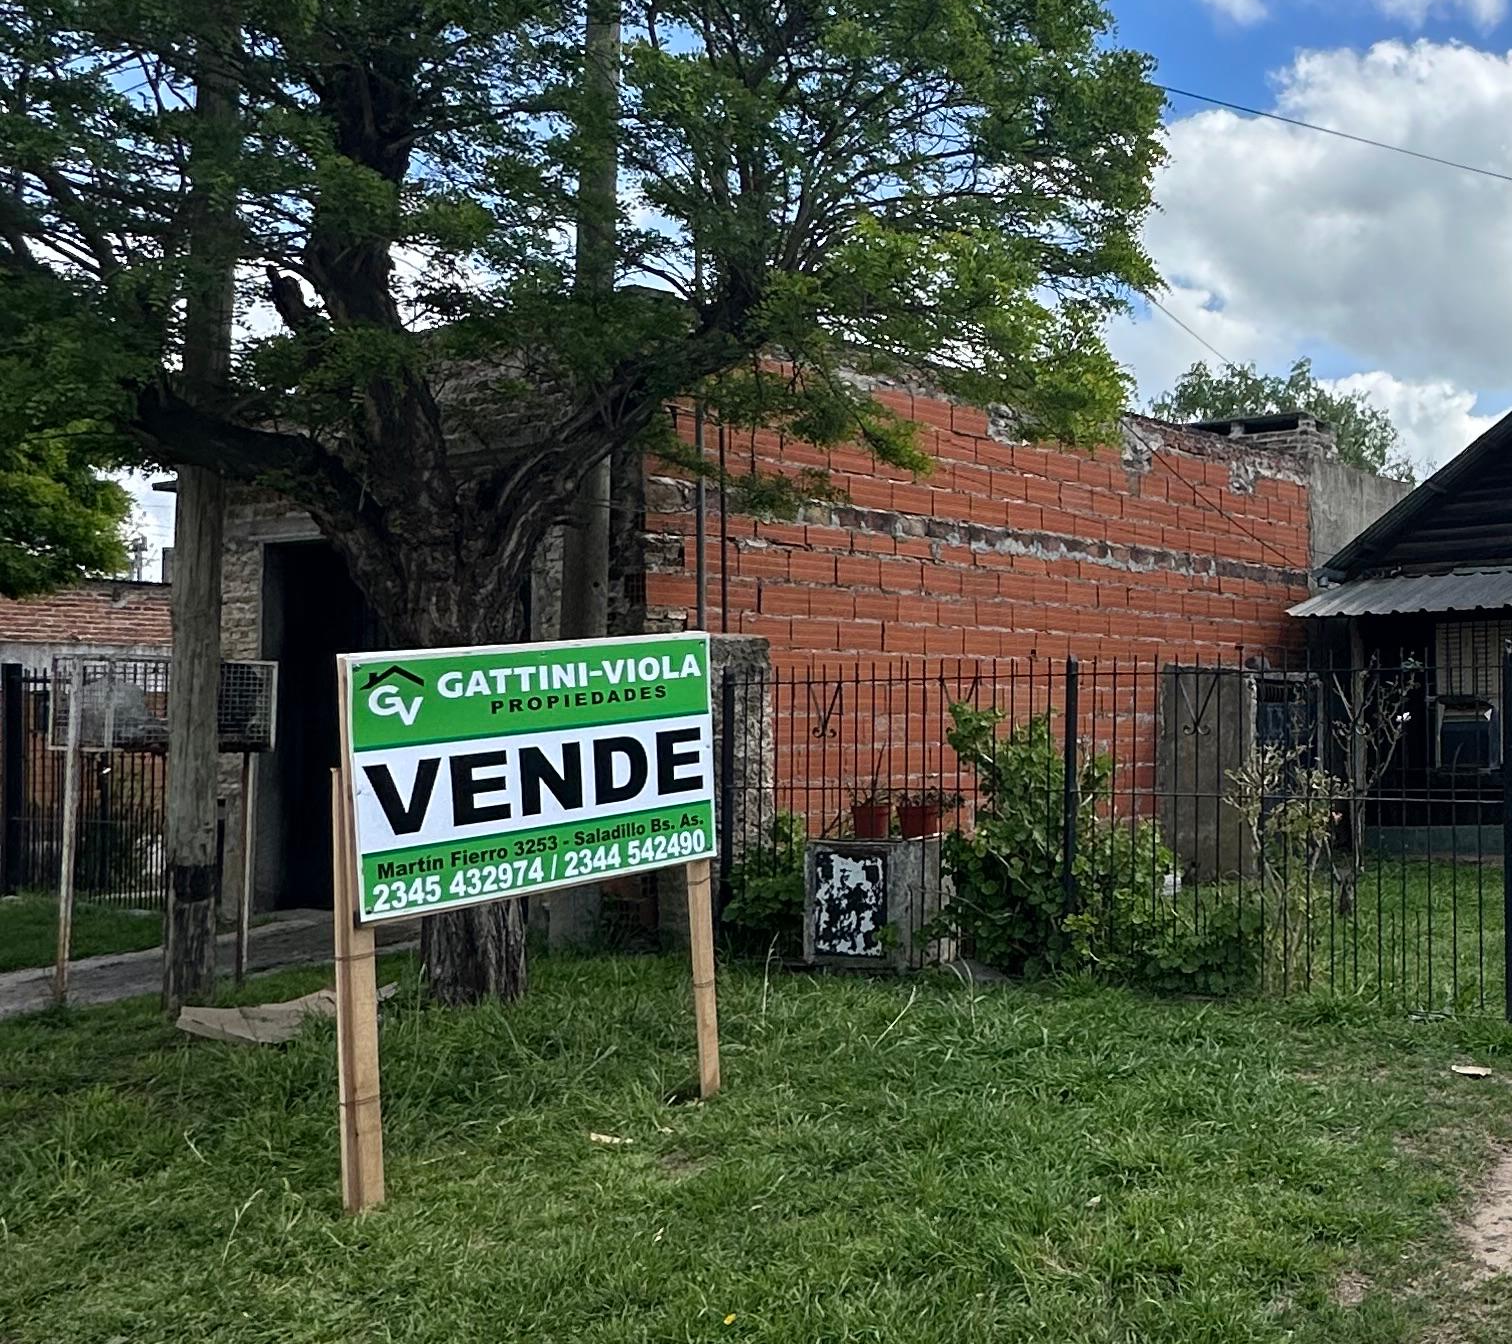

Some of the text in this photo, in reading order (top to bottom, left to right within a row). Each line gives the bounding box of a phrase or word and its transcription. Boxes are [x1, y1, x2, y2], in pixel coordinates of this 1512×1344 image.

[437, 654, 702, 699] GATTINI-VIOLA
[491, 685, 667, 715] PROPIEDADES
[363, 727, 704, 836] VENDE
[373, 874, 442, 912] 2345
[449, 857, 544, 897] 432974
[564, 843, 621, 878] 2344
[627, 828, 705, 865] 542490
[377, 856, 444, 880] Martín
[450, 847, 508, 868] Fierro
[513, 835, 558, 857] 3253
[574, 822, 646, 846] Saladillo
[651, 818, 676, 833] Bs.
[680, 813, 704, 828] As.
